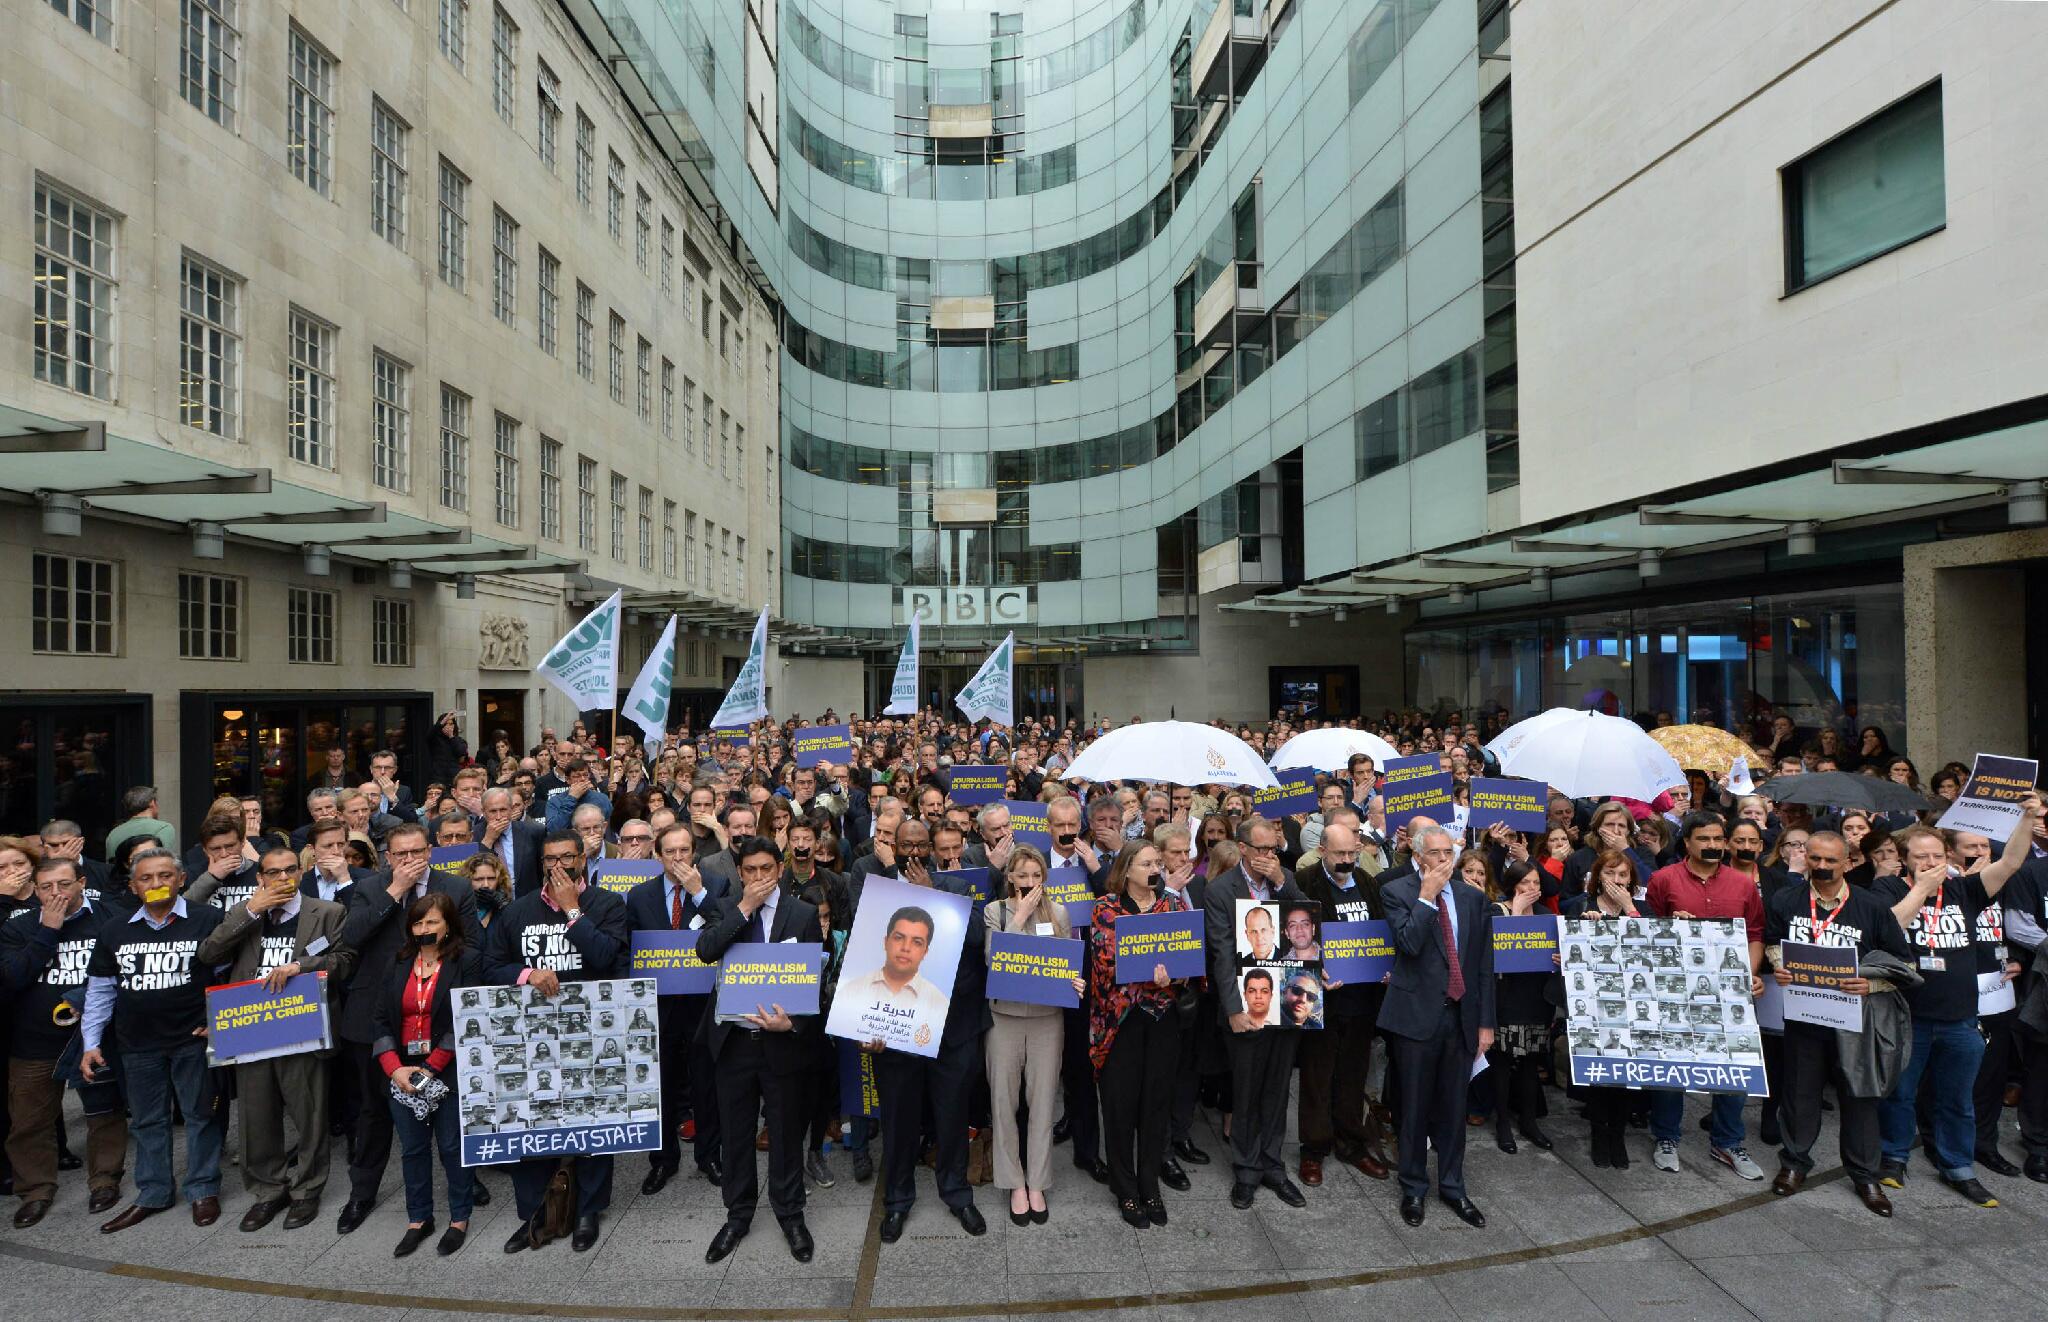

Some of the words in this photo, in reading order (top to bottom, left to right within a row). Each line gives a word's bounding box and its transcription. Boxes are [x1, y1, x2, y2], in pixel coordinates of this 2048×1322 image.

[912, 592, 1021, 620] BBC
[797, 736, 842, 746] JOURNALISM
[828, 741, 849, 749] CRIME
[1387, 765, 1432, 776] JOURNALISM
[1975, 775, 2032, 788] JOURNALISM
[1264, 793, 1280, 802] NOT
[1290, 786, 1314, 796] CRIME
[1386, 788, 1442, 806] JOURNALISM
[1473, 792, 1536, 804] JOURNALISM
[1975, 786, 1990, 796] IS
[1993, 788, 2024, 800] NOT
[1386, 805, 1395, 814] IS
[1397, 801, 1414, 812] NOT
[1416, 800, 1423, 808] A
[1424, 794, 1452, 806] CRIME
[1473, 800, 1481, 808] IS
[1483, 800, 1503, 810] NOT
[1504, 802, 1512, 811] A
[1514, 803, 1544, 813] CRIME
[1011, 814, 1048, 826] URNALIS
[599, 875, 656, 884] JOURNAL
[1046, 883, 1086, 894] NALISM
[1065, 892, 1096, 903] CRIME
[1118, 930, 1192, 946] JOURNALISM
[1493, 932, 1546, 941] URNALISM
[1789, 926, 1810, 944] IS
[1916, 931, 1969, 948] CRIME
[58, 938, 97, 952] NALIS
[114, 940, 198, 955] JOURNALISM
[521, 935, 540, 957] IS
[1119, 947, 1129, 956] IS
[1132, 944, 1155, 956] NOT
[1157, 943, 1166, 953] A
[1168, 940, 1202, 951] CRIME
[1324, 937, 1384, 949] JOURNALISM
[1493, 941, 1513, 950] NOT
[1516, 941, 1522, 949] A
[1524, 940, 1557, 949] CRIME
[58, 950, 92, 971] NO
[261, 948, 294, 966] NO
[633, 948, 696, 959] JOURNALIS
[992, 951, 1069, 968] JOURNALISM
[1324, 950, 1334, 959] IS
[1336, 949, 1355, 957] NOT
[1357, 948, 1365, 957] A
[1366, 947, 1396, 957] CRIME
[116, 954, 137, 975] IS
[144, 951, 196, 974] NOT
[536, 954, 583, 972] CRIME
[633, 960, 644, 969] IS
[647, 959, 671, 969] NOT
[672, 959, 681, 967] A
[725, 963, 807, 974] JOURNALISM
[1787, 961, 1855, 974] JOURNALISM
[992, 962, 1002, 972] IS
[1005, 963, 1028, 975] NOT
[1031, 967, 1040, 977] A
[1042, 967, 1079, 980] CRIME
[1794, 973, 1809, 983] IS
[131, 971, 192, 991] CRIME
[724, 974, 736, 985] IS
[739, 974, 765, 985] NOT
[768, 974, 777, 984] A
[779, 974, 818, 984] CRIME
[215, 994, 304, 1020] JOURNALISM
[883, 1003, 915, 1019] الحرية
[216, 1020, 229, 1031] IS
[232, 1013, 261, 1028] NOT
[264, 1011, 273, 1021] A
[275, 1002, 318, 1019] CRIME
[861, 1053, 869, 1073] NOT
[1583, 1061, 1752, 1088] #FREEAJSTAFF
[476, 1123, 649, 1161] #FREEAJSTAFF
